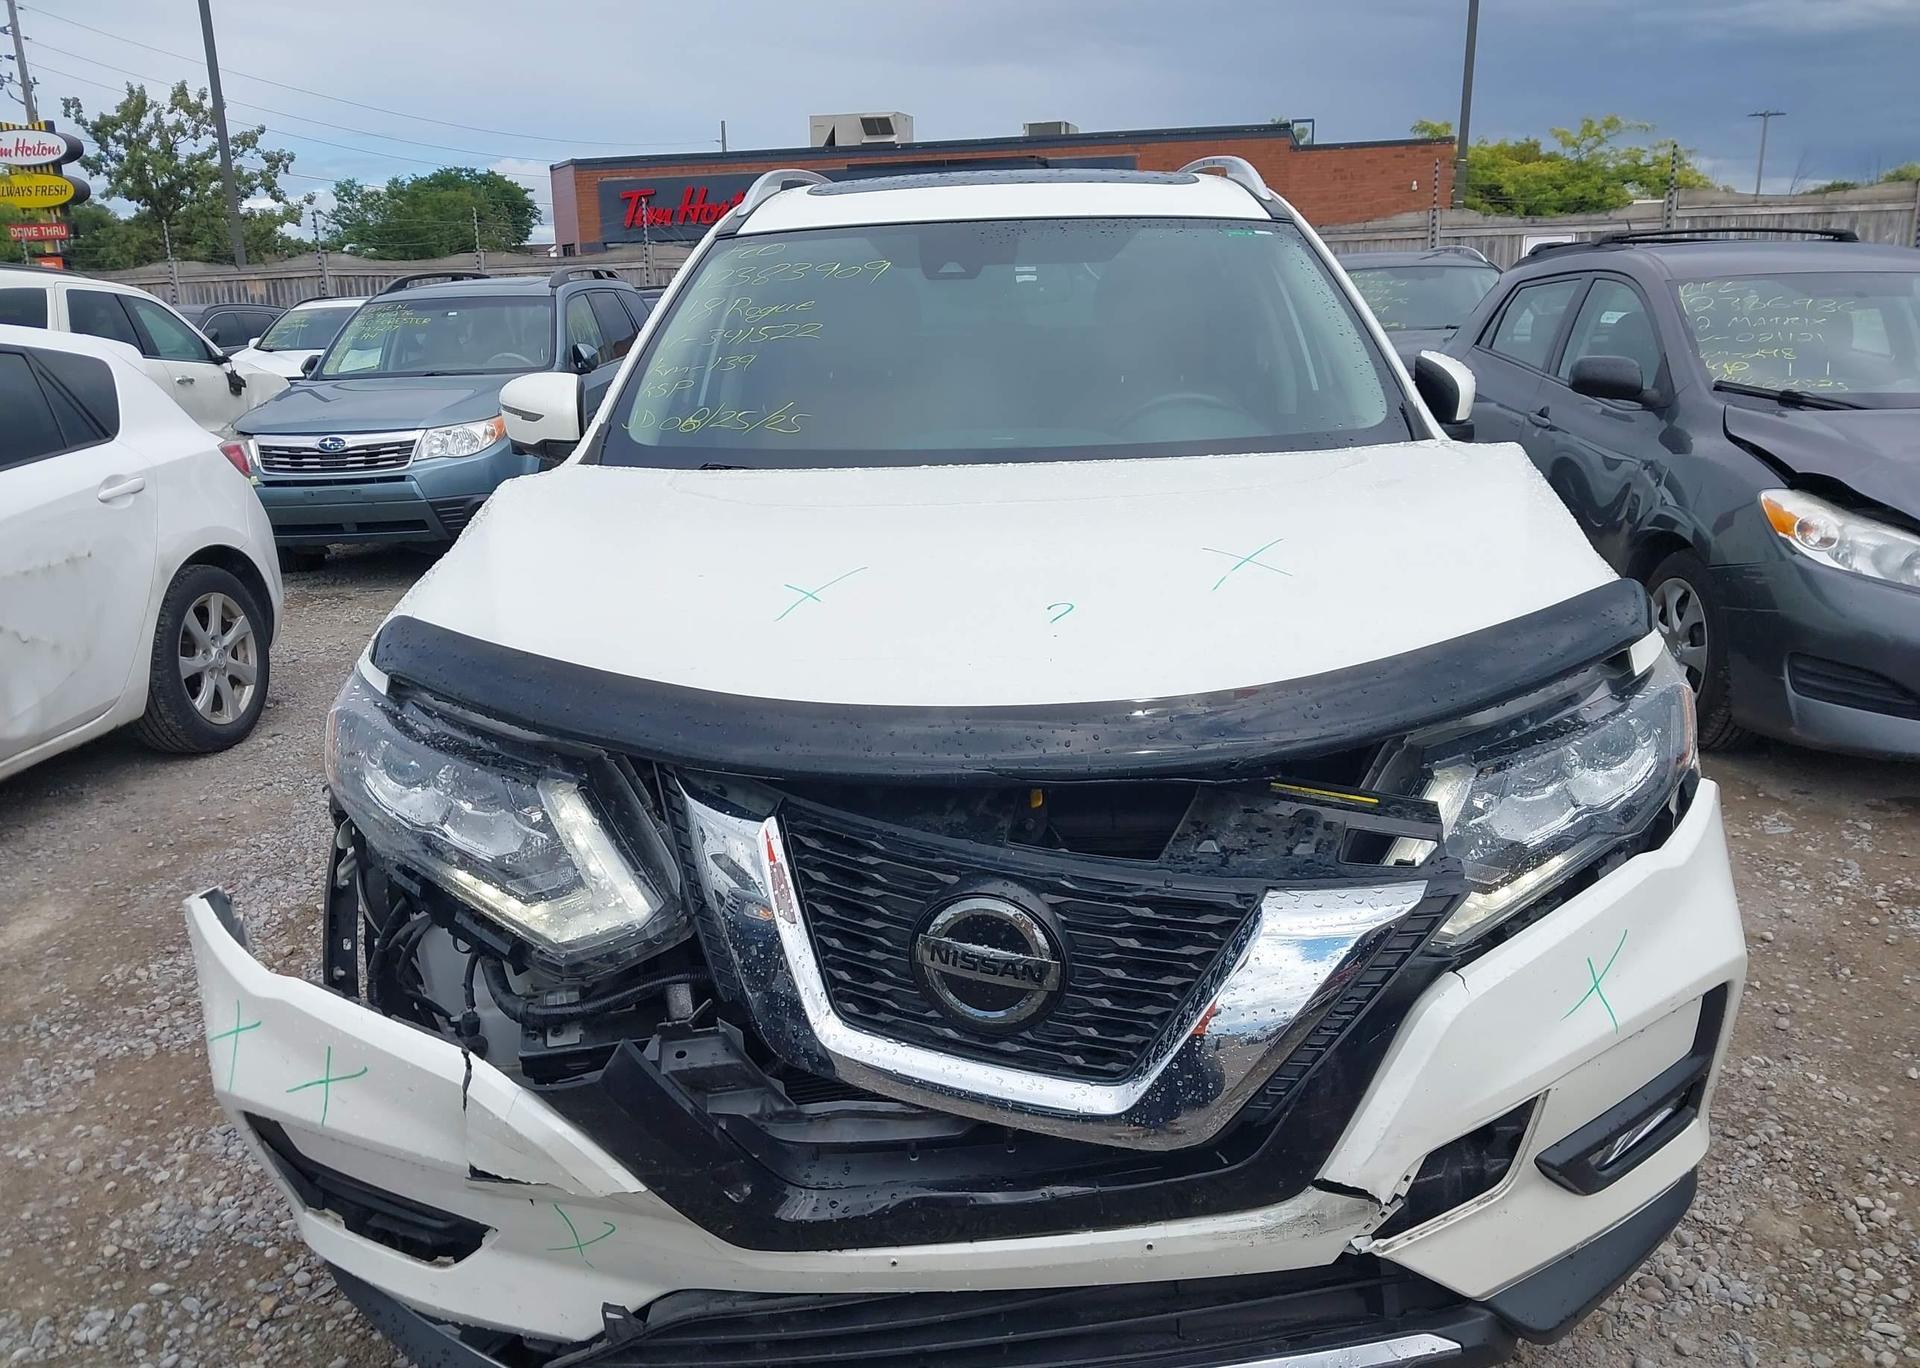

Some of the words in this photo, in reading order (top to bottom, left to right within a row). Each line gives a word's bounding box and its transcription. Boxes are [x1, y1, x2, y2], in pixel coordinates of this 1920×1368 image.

[15, 138, 61, 157] Hortons
[0, 185, 33, 198] LWAYS
[35, 184, 68, 197] FRESH
[619, 187, 674, 229] Tim
[10, 227, 40, 238] DRIVE
[40, 226, 66, 236] THRU
[726, 296, 816, 323] Rogue
[928, 942, 1045, 985] NISSAN
